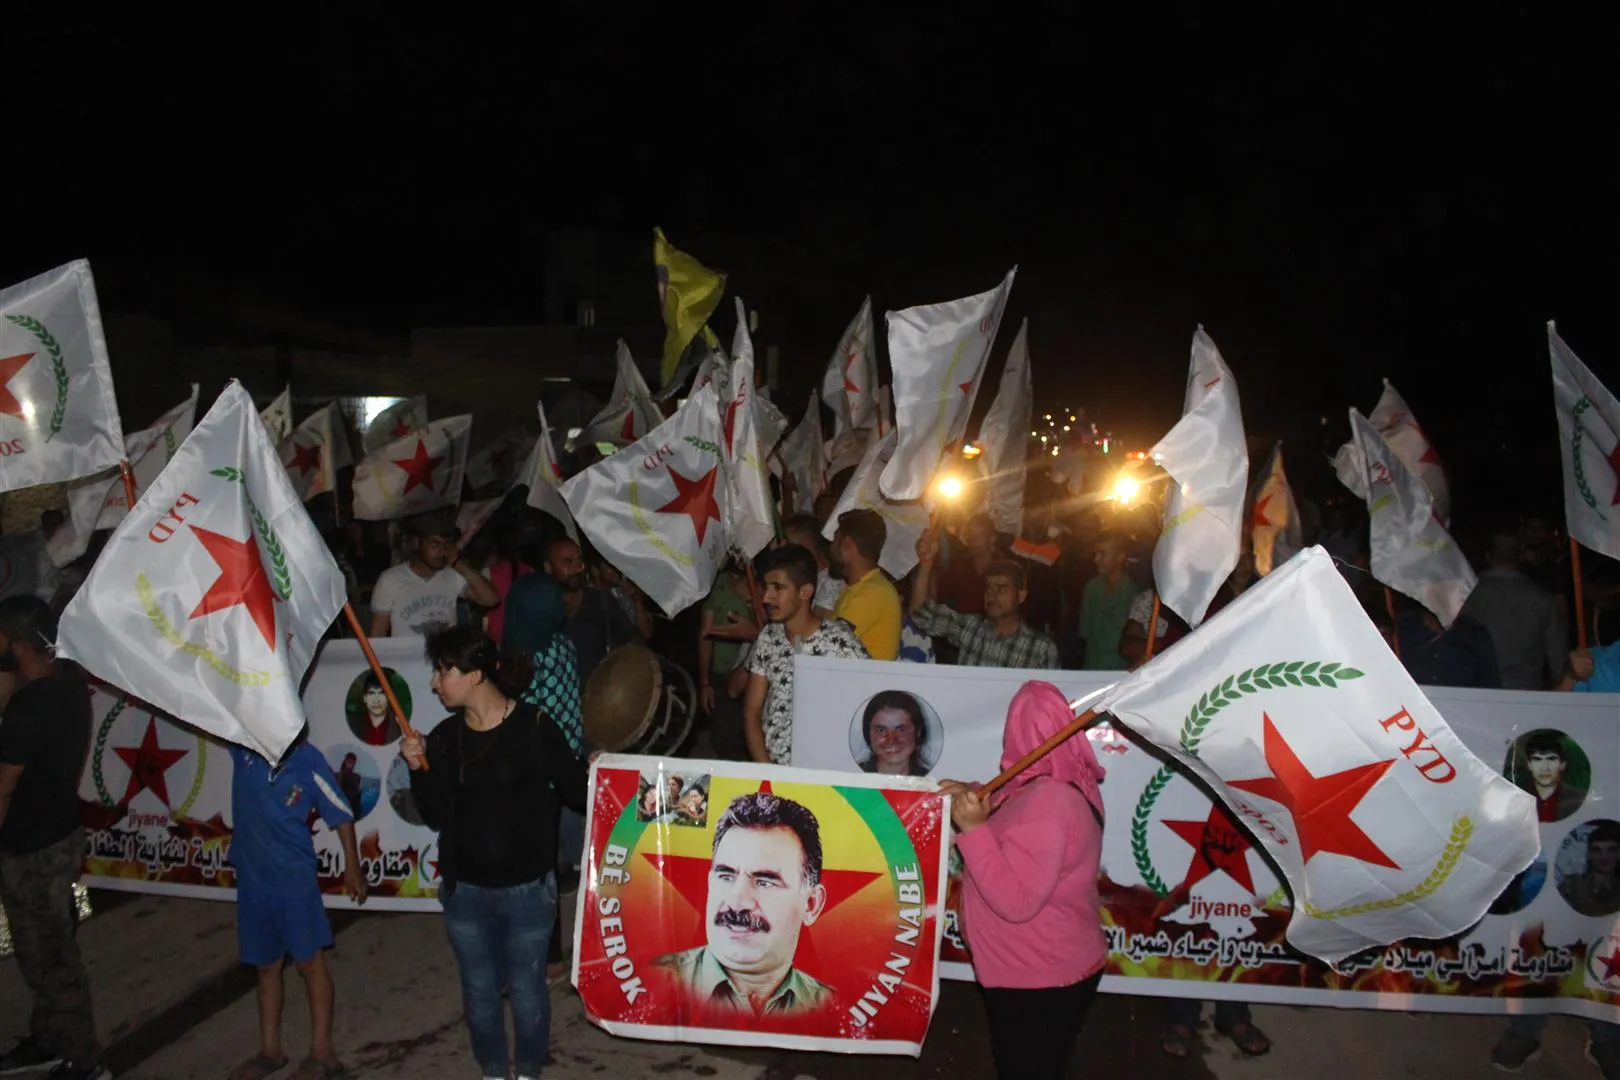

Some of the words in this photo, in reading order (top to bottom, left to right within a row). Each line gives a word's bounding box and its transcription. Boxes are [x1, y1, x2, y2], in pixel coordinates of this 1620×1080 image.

[1378, 705, 1456, 783] PYD
[128, 808, 168, 828] jiyane
[1230, 798, 1288, 845] 2003
[361, 851, 411, 885] مقاوم
[600, 844, 631, 885] BÊ
[1188, 896, 1252, 920] jiyane
[599, 897, 647, 1005] SEROK
[849, 952, 911, 1027] JIYAN
[895, 862, 921, 946] NABE
[1511, 949, 1573, 980] مقاومة
